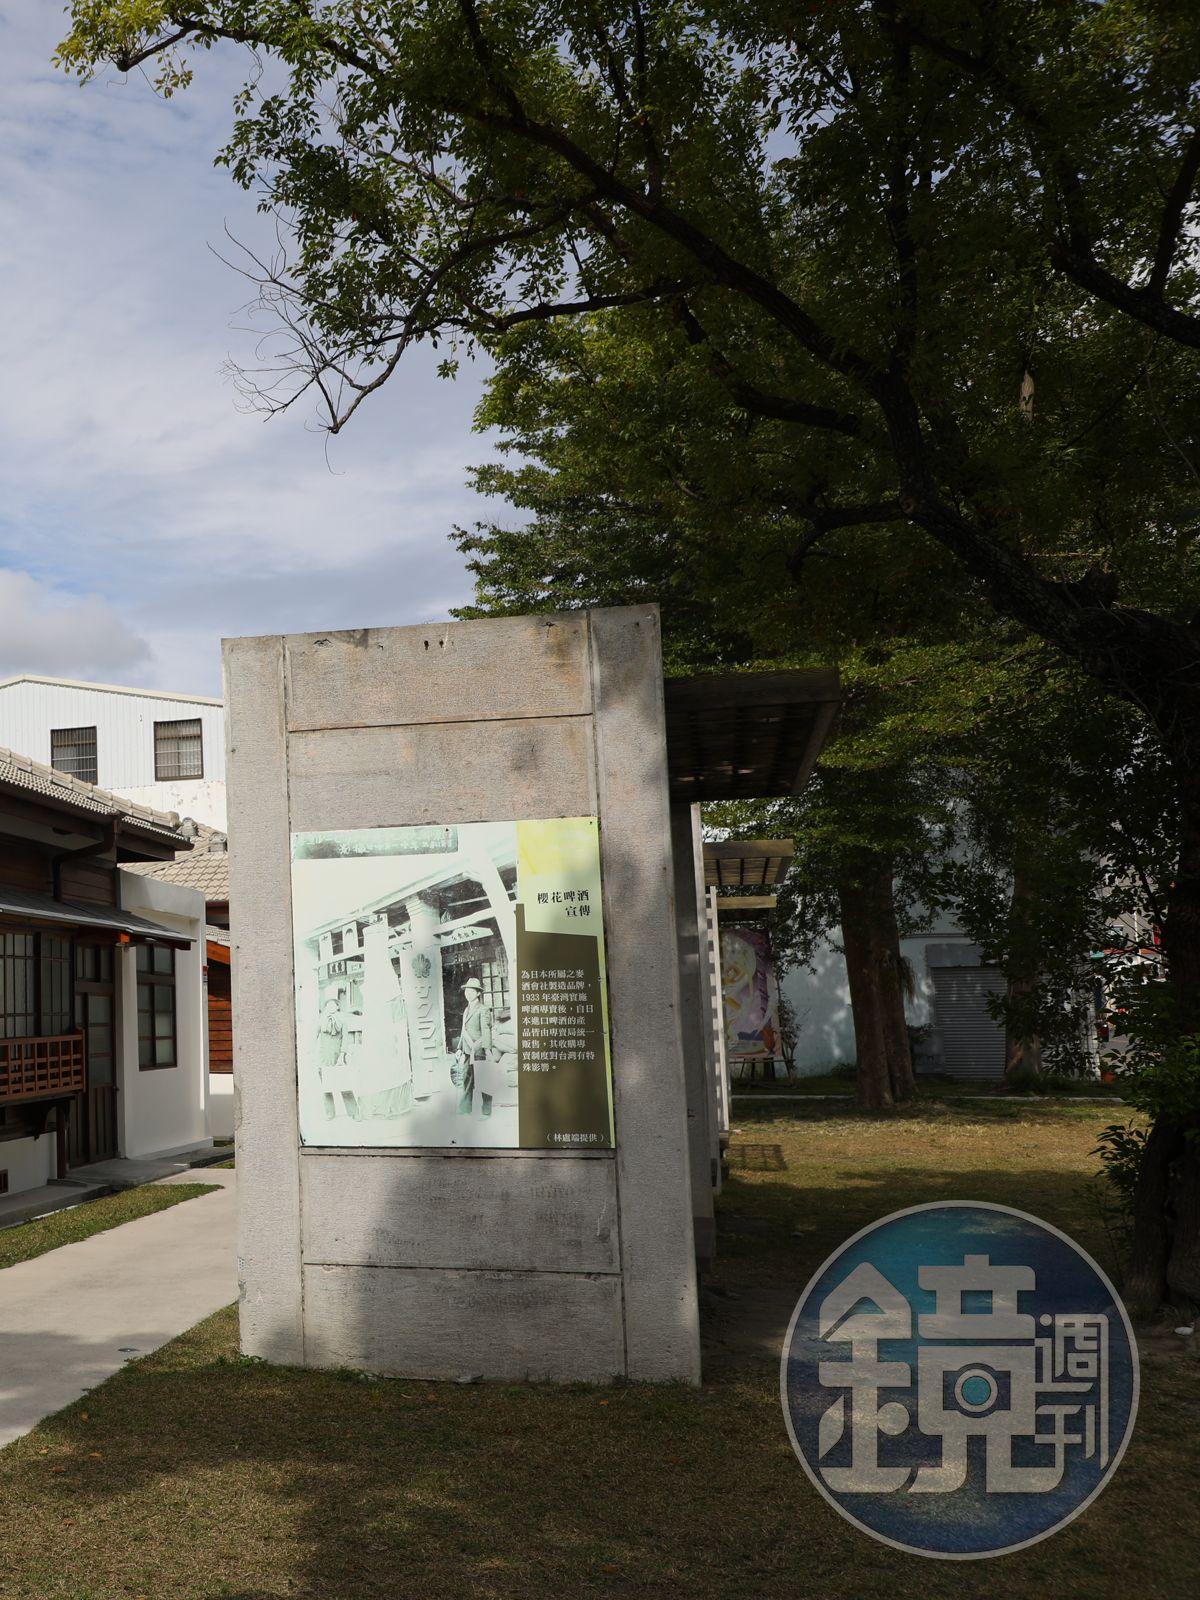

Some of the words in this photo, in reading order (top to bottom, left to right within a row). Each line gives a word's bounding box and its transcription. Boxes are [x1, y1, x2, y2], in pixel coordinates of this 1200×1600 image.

[537, 889, 590, 905] 櫻花啤酒
[565, 904, 591, 917] 宣傳
[522, 993, 540, 1002] 1933
